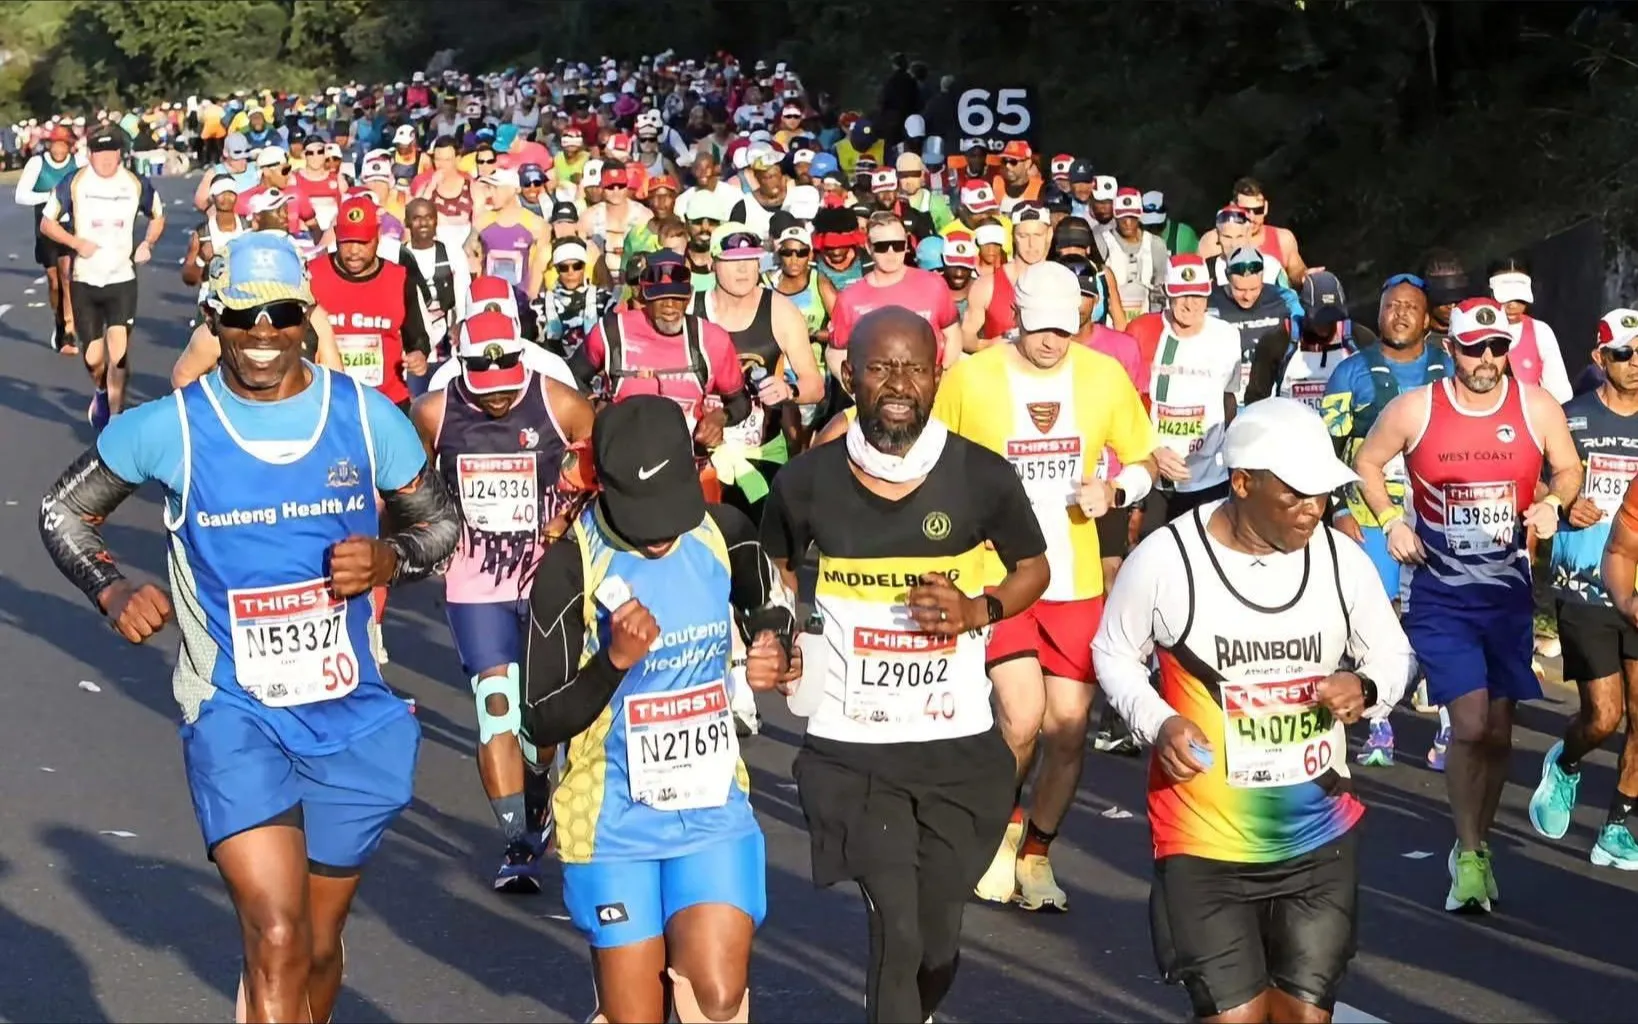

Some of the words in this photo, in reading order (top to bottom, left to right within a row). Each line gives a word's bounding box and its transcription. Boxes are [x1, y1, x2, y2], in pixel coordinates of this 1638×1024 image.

[958, 88, 1031, 135] 65
[988, 137, 1005, 152] to
[1157, 418, 1204, 436] H42345
[1438, 452, 1469, 462] WEST
[1474, 451, 1514, 461] COAST
[468, 480, 530, 500] J24836
[197, 509, 277, 528] Gauteng
[282, 501, 344, 519] Health
[346, 494, 366, 512] AC
[511, 503, 535, 524] 40
[1451, 505, 1509, 525] L39866
[1492, 526, 1513, 547] 40
[246, 615, 340, 659] N53327
[1214, 631, 1322, 671] RAINBOW
[321, 651, 354, 692] 50
[642, 645, 706, 677] Health
[704, 640, 728, 661] AC
[860, 657, 949, 688] L29062
[1244, 667, 1281, 676] Athletic
[1285, 665, 1304, 674] Club
[922, 691, 956, 721] 40
[640, 721, 730, 764] N27699
[1303, 739, 1332, 776] 60
